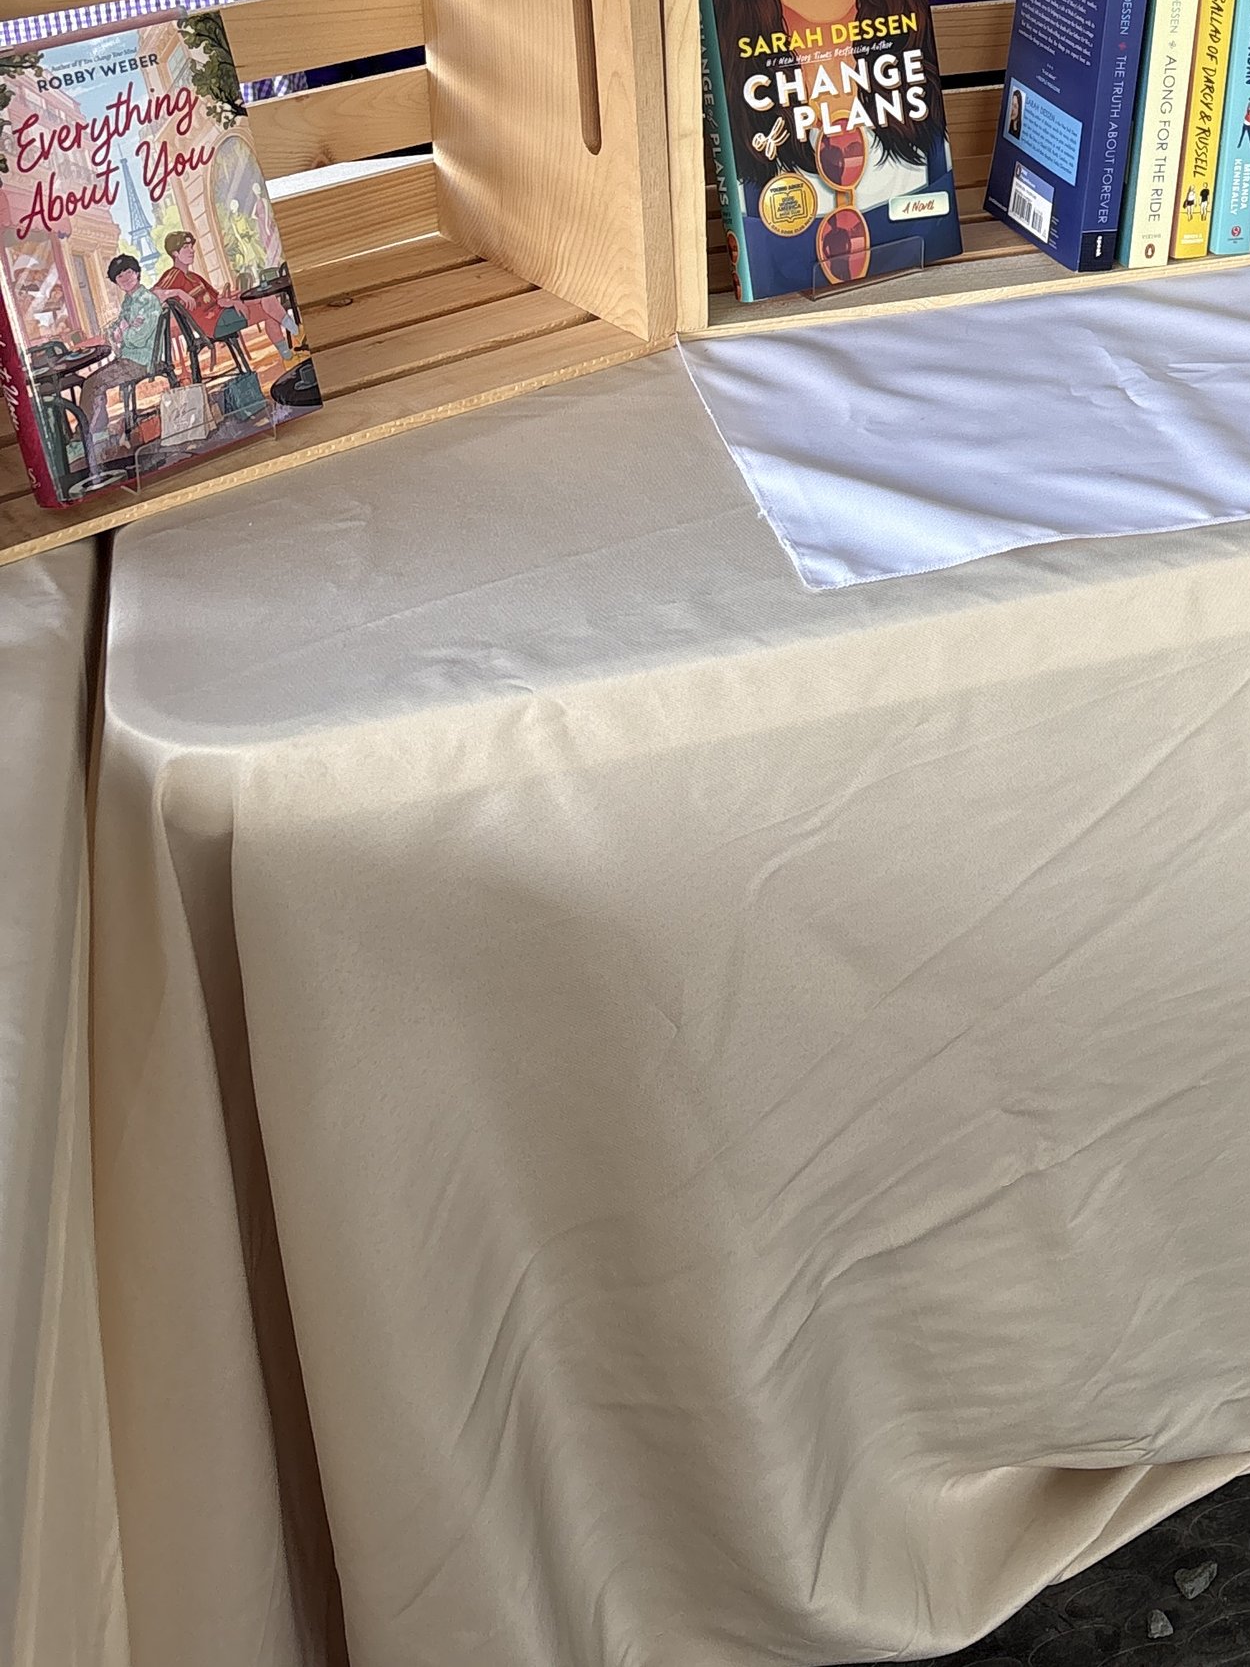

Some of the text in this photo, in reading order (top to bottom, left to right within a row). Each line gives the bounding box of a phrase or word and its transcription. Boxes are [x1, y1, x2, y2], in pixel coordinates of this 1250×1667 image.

[738, 12, 918, 58] SARAH DESSEN
[37, 53, 160, 93] ROBBY WEBER
[743, 49, 927, 112] CHANGE
[13, 81, 200, 174] Everything
[793, 86, 929, 142] PLANS
[16, 141, 216, 240] About You
[1230, 159, 1242, 216] KENNEALLY
